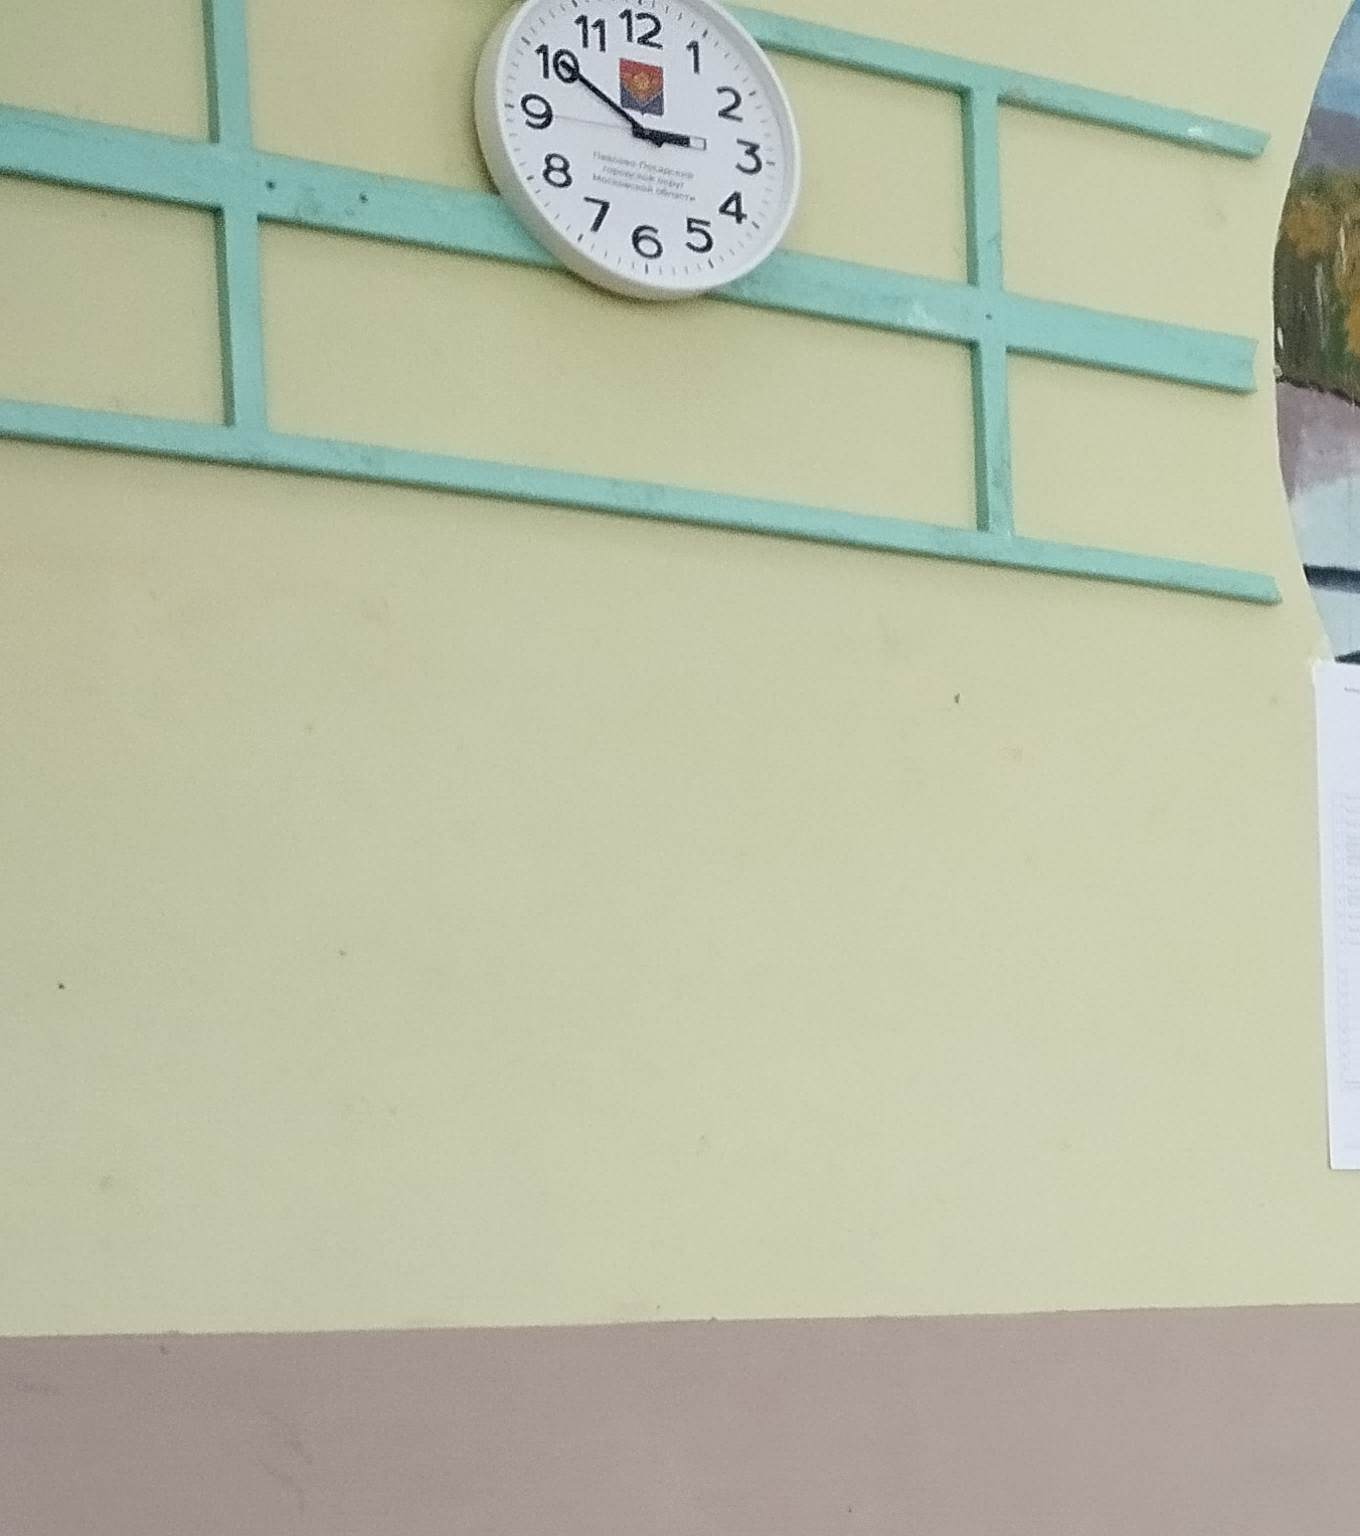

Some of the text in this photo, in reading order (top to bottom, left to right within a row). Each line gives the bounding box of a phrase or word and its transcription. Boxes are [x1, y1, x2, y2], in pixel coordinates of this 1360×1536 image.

[575, 15, 606, 52] 11
[619, 9, 663, 49] 12
[535, 43, 580, 84] 10
[686, 40, 700, 74] 1
[520, 93, 553, 130] 9
[716, 86, 743, 122] 2
[542, 153, 573, 188] 8
[735, 138, 763, 175] 3
[583, 197, 610, 232] 7
[718, 191, 748, 225] 4
[631, 225, 663, 259] 6
[685, 216, 714, 253] 5
